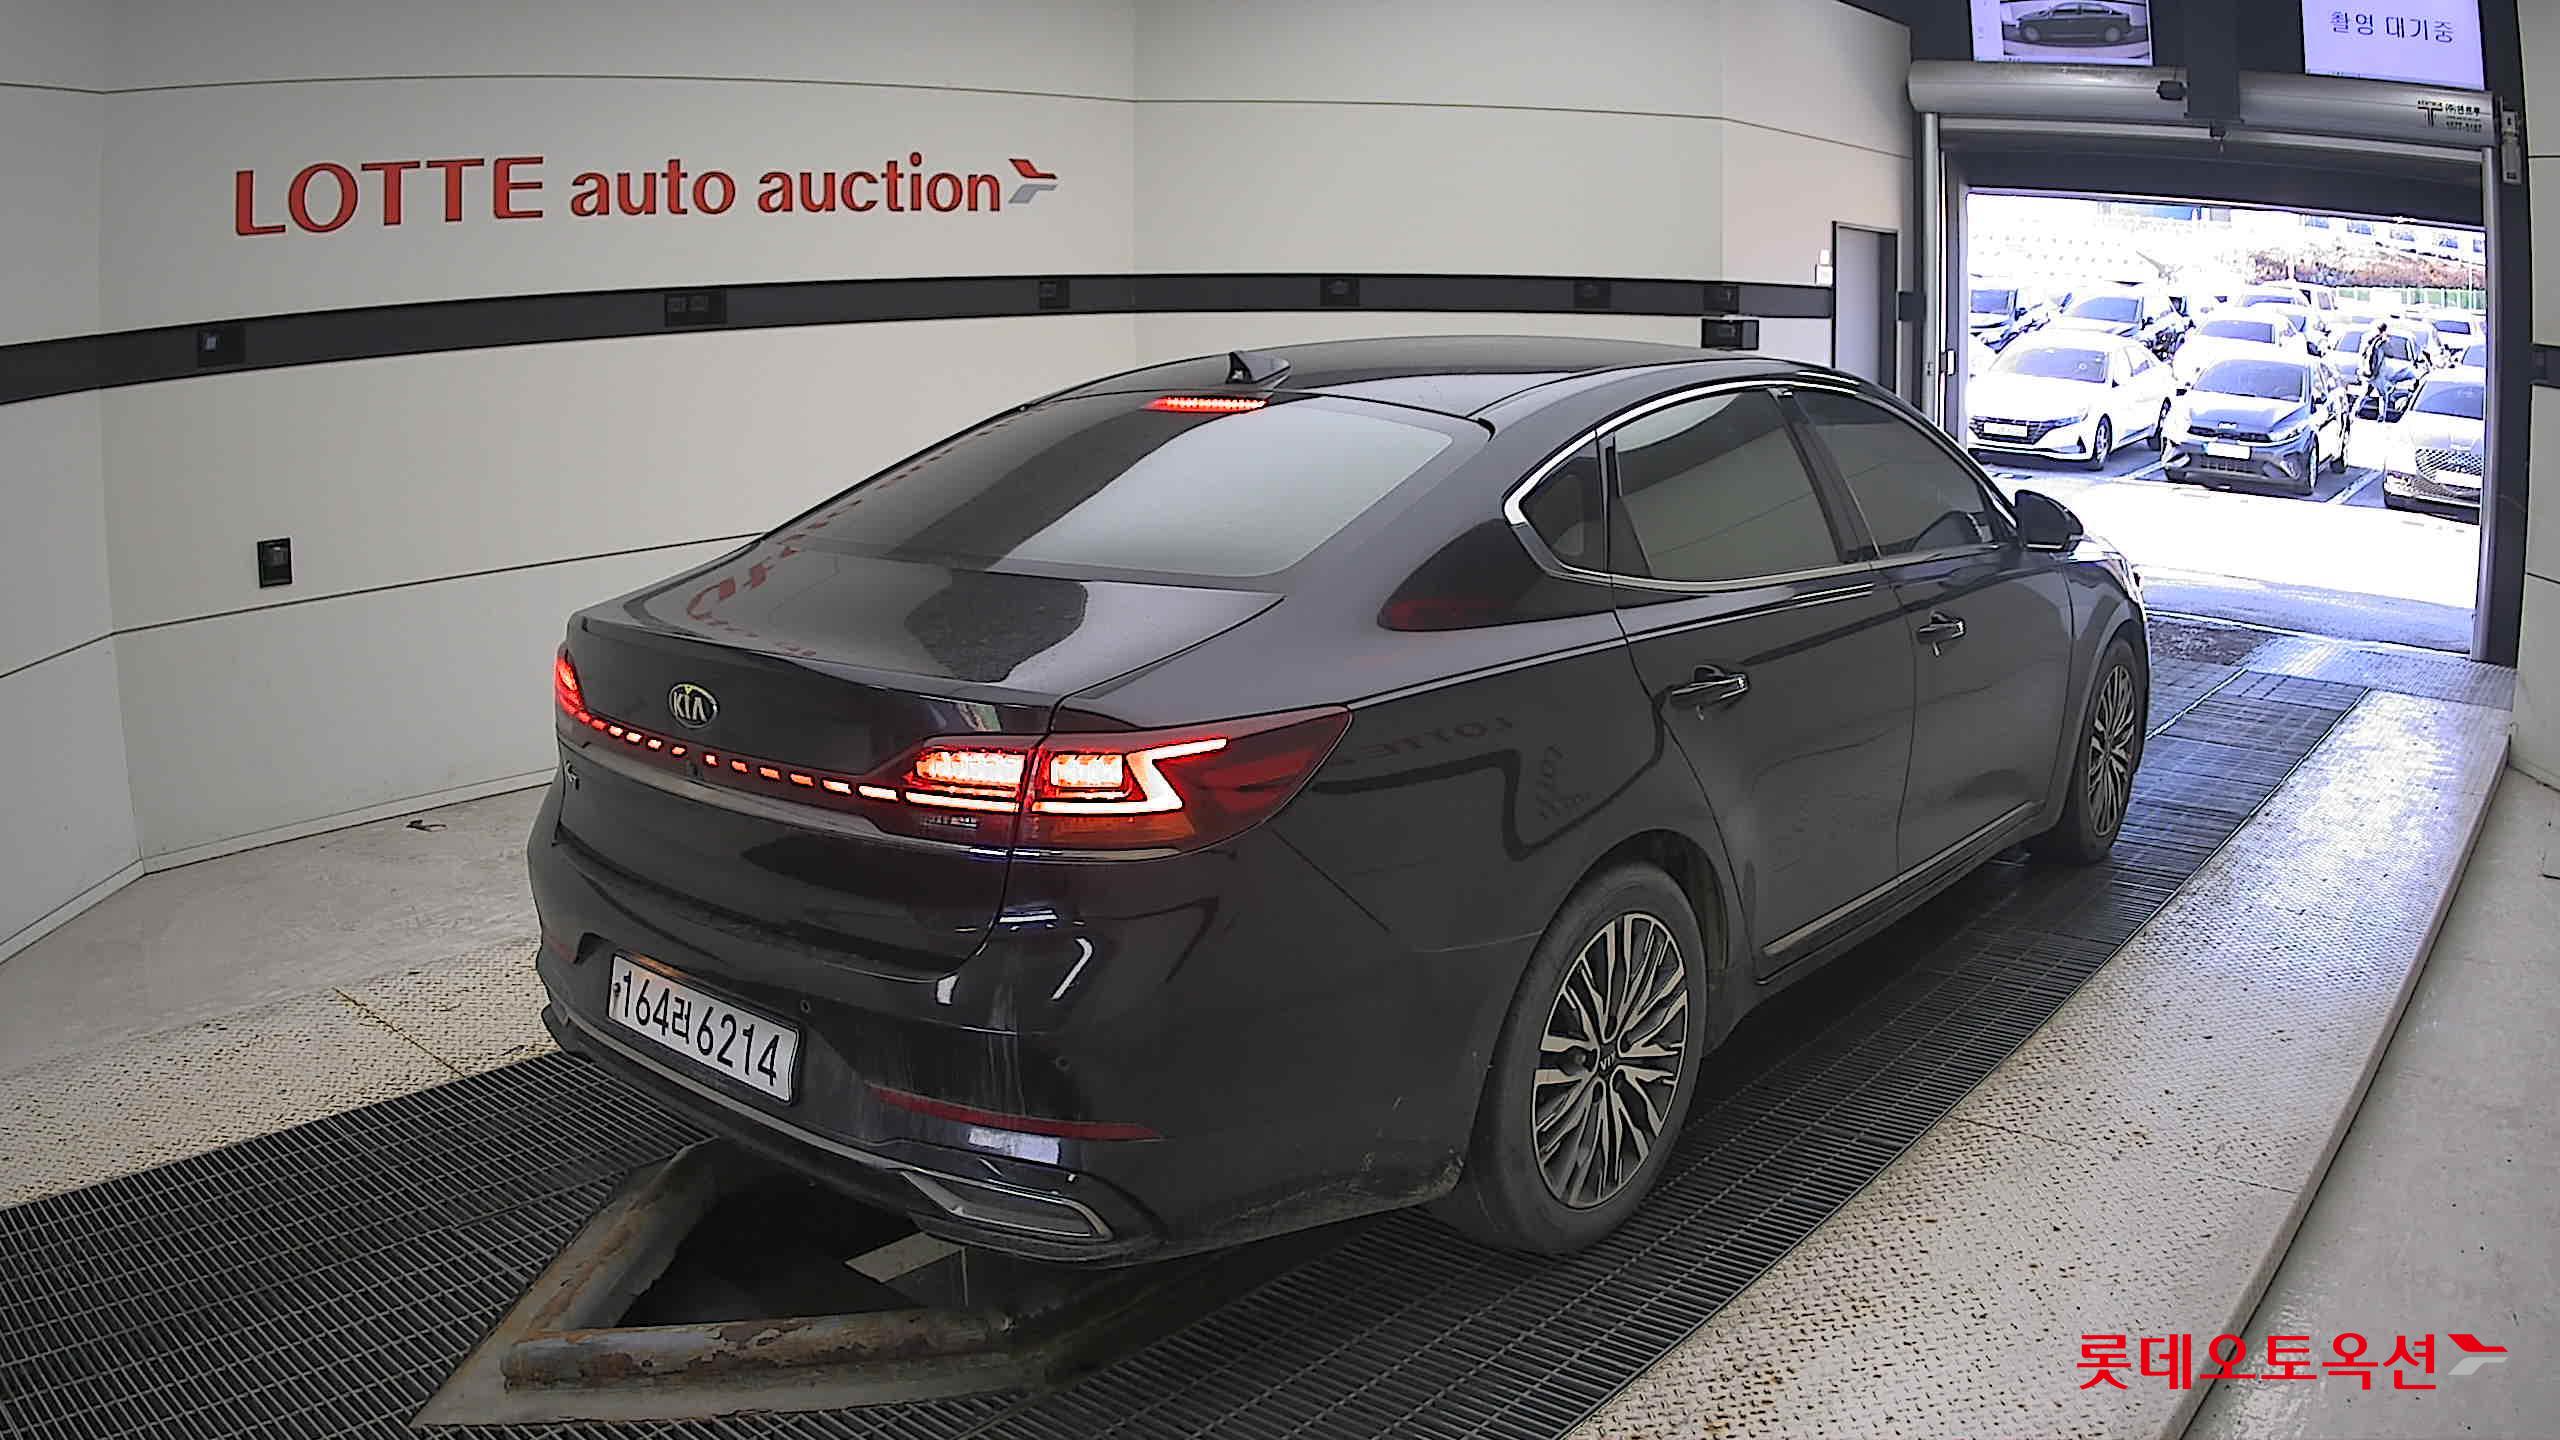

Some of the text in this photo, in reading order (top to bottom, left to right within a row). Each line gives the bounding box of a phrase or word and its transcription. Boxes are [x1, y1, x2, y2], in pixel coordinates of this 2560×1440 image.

[2330, 11, 2453, 43] 촬영 대기중
[236, 152, 1001, 237] LOTTE auto auction
[673, 690, 708, 722] KIA
[623, 969, 778, 1087] 164러6214
